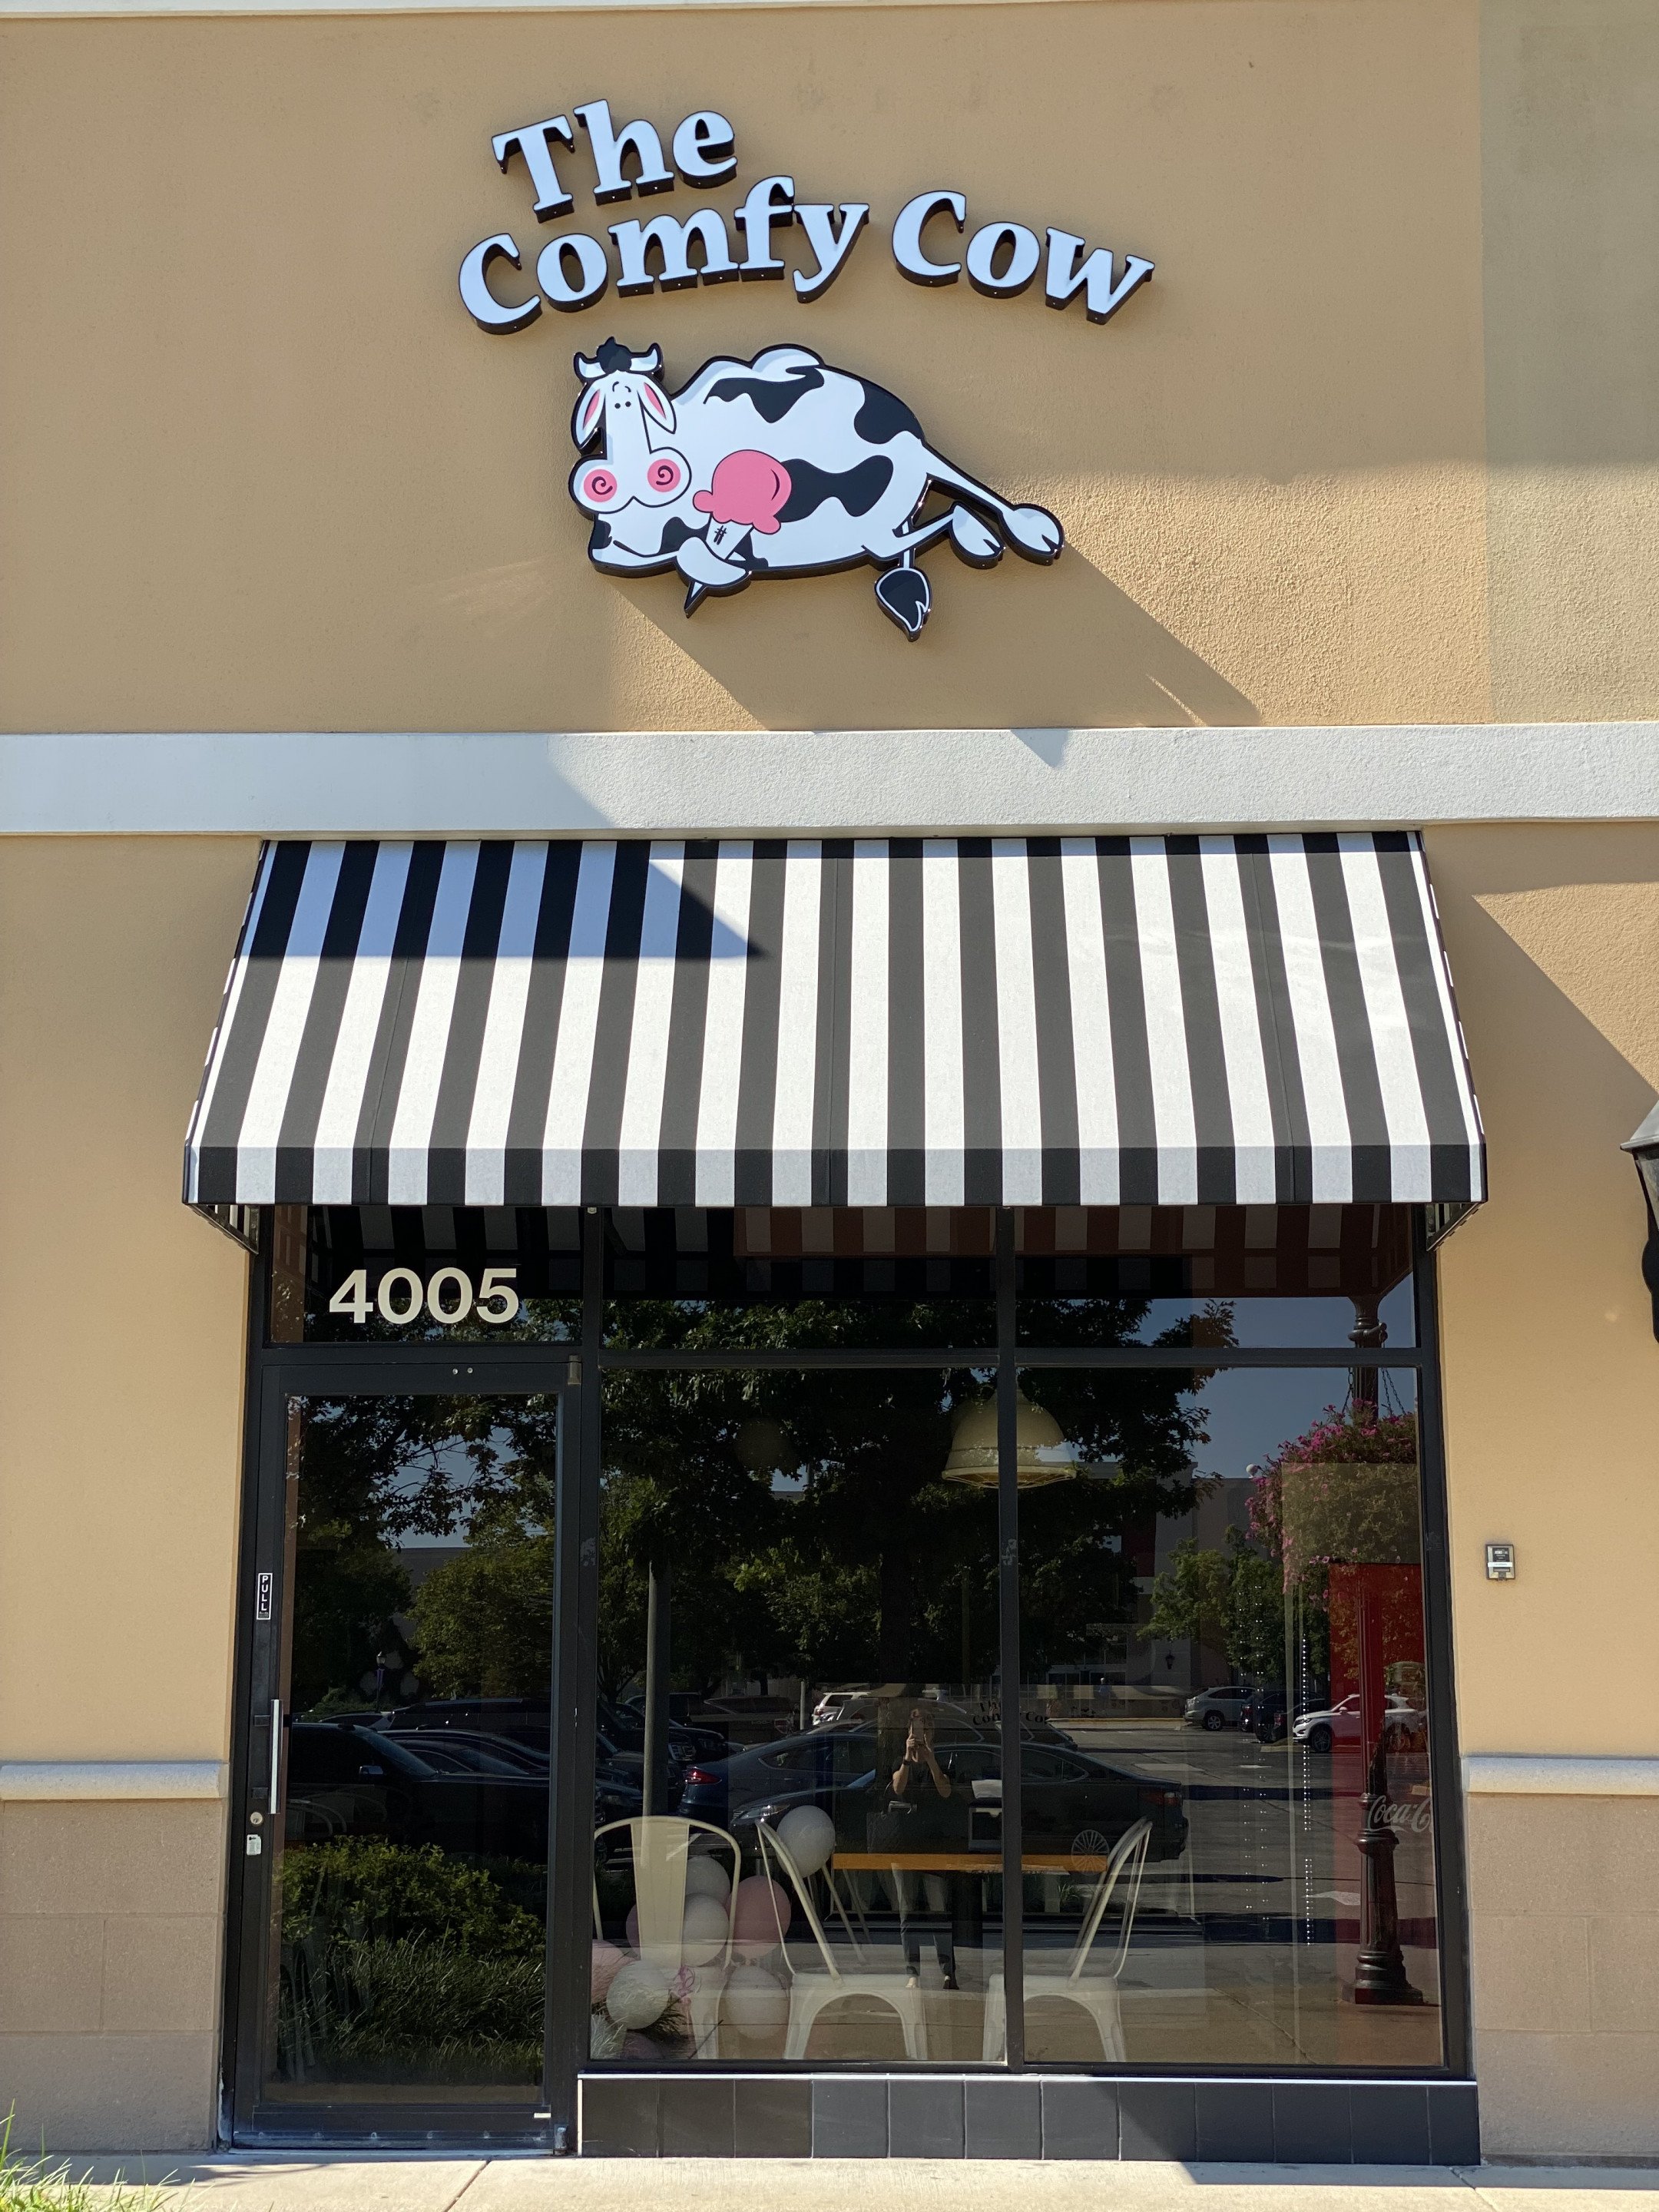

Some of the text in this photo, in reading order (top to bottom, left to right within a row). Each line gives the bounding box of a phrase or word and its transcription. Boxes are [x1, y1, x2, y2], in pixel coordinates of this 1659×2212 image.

[492, 98, 737, 223] The
[458, 175, 1155, 333] Comfy Cow
[329, 1267, 519, 1325] 4005
[1368, 1795, 1432, 1833] Coca-C
